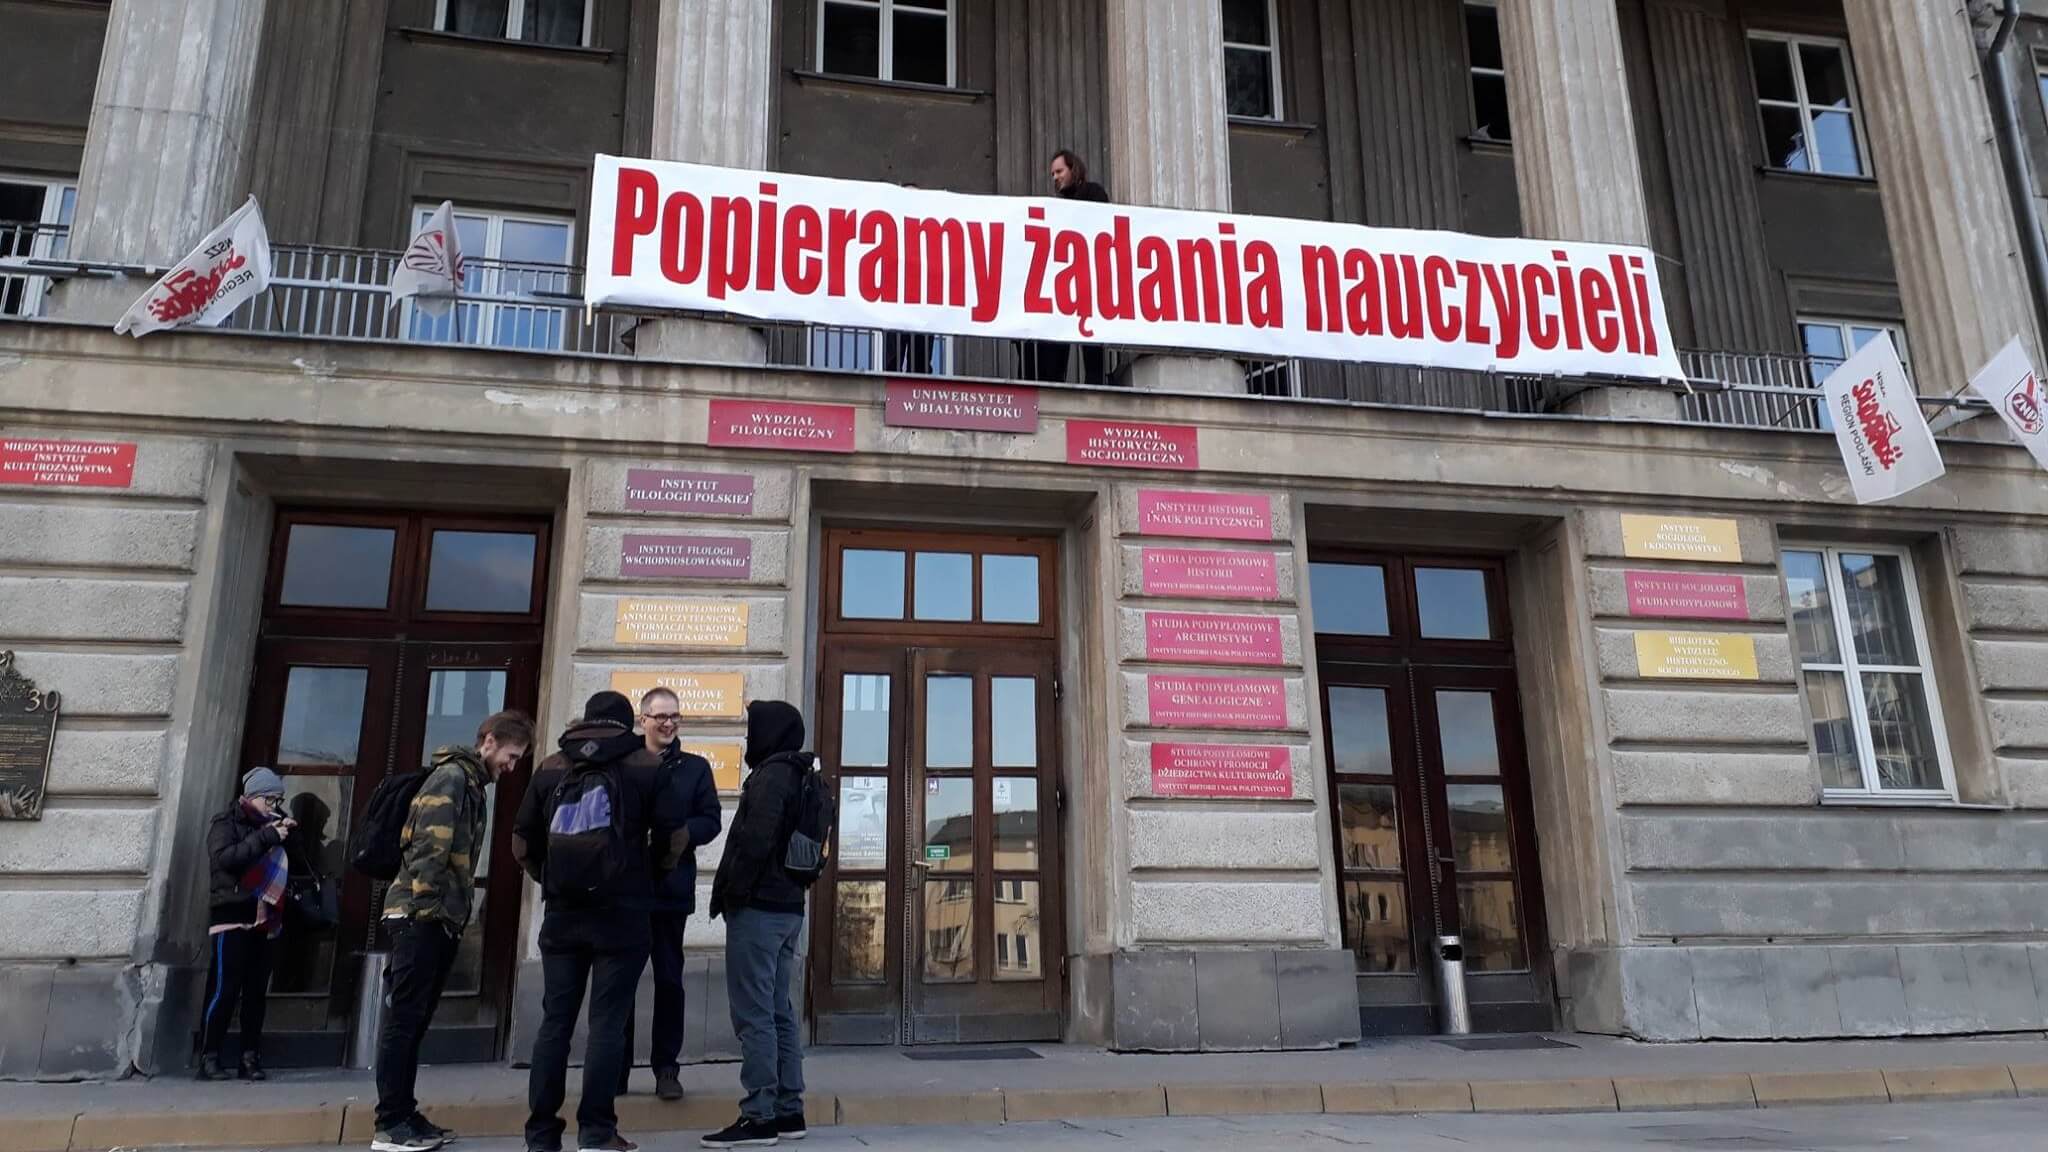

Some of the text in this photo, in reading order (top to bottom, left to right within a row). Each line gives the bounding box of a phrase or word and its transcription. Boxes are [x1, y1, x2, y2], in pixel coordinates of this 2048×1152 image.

[611, 166, 1658, 359] Popieramy żądania nauczycieli
[912, 389, 1014, 405] UNIWERSYTET
[903, 402, 1022, 418] W BIAŁYMSTOKU
[1841, 393, 1856, 429] REGION
[751, 413, 815, 426] WYDZIAŁ
[730, 425, 834, 439] FILOLOGICZNY
[1103, 427, 1161, 440] WYDZIAŁ
[1089, 438, 1177, 452] HISTORYCZNO
[34, 453, 86, 463] INSTYTUT
[1081, 449, 1184, 464] SOCJOLOGICZNY
[3, 462, 113, 474] KULTUROZNAWSTWA
[34, 473, 79, 482] I SZTUKI
[661, 479, 718, 491] INSTYTUT
[630, 490, 750, 504] FILOLOGII POLSKIEJ
[1156, 501, 1254, 515] INSTYTUT HISTORII
[1146, 513, 1264, 529] I NAUK POLITYCZNYCH
[1661, 523, 1700, 533] INSTYTUT
[1657, 533, 1706, 543] SOCJOLOGII
[639, 545, 734, 556] INSTYTUT FILOLOGII
[1148, 553, 1270, 568] STUDIA PODYPLOMOWE
[1187, 567, 1233, 578] HISTORII
[1634, 580, 1736, 594] INSTYTUT SOCJOLOGII
[629, 603, 737, 613] STUDIA PODYPLOMOWE
[1636, 597, 1738, 609] STUDIA PODYPLOMOWE
[623, 613, 741, 622] ANIMACJI CZYTELNICTWA
[626, 623, 739, 633] INFORMACJI NAUKOWEJ
[1152, 618, 1274, 633] STUDIA PODYPLOMOWE
[640, 632, 729, 641] BIBLIOTEKARSTWA
[1175, 632, 1253, 644] ARCHIWISTYKI
[1669, 636, 1720, 646] BIBLIOTEKA
[656, 677, 700, 687] STUDIA
[1154, 681, 1279, 695] STUDIA PODYPLOMOWE
[25, 688, 60, 712] 30
[1172, 694, 1264, 706] GENEALOGICZNE
[1170, 748, 1271, 759] STUDIA PODYPLOMOWE
[1174, 759, 1218, 768] OCHRONY
[1223, 760, 1268, 770] PROMOCJI
[1158, 769, 1286, 781] DZIEDZICTWA KULTUROWEGO
[1158, 783, 1189, 791] INSTYTUT
